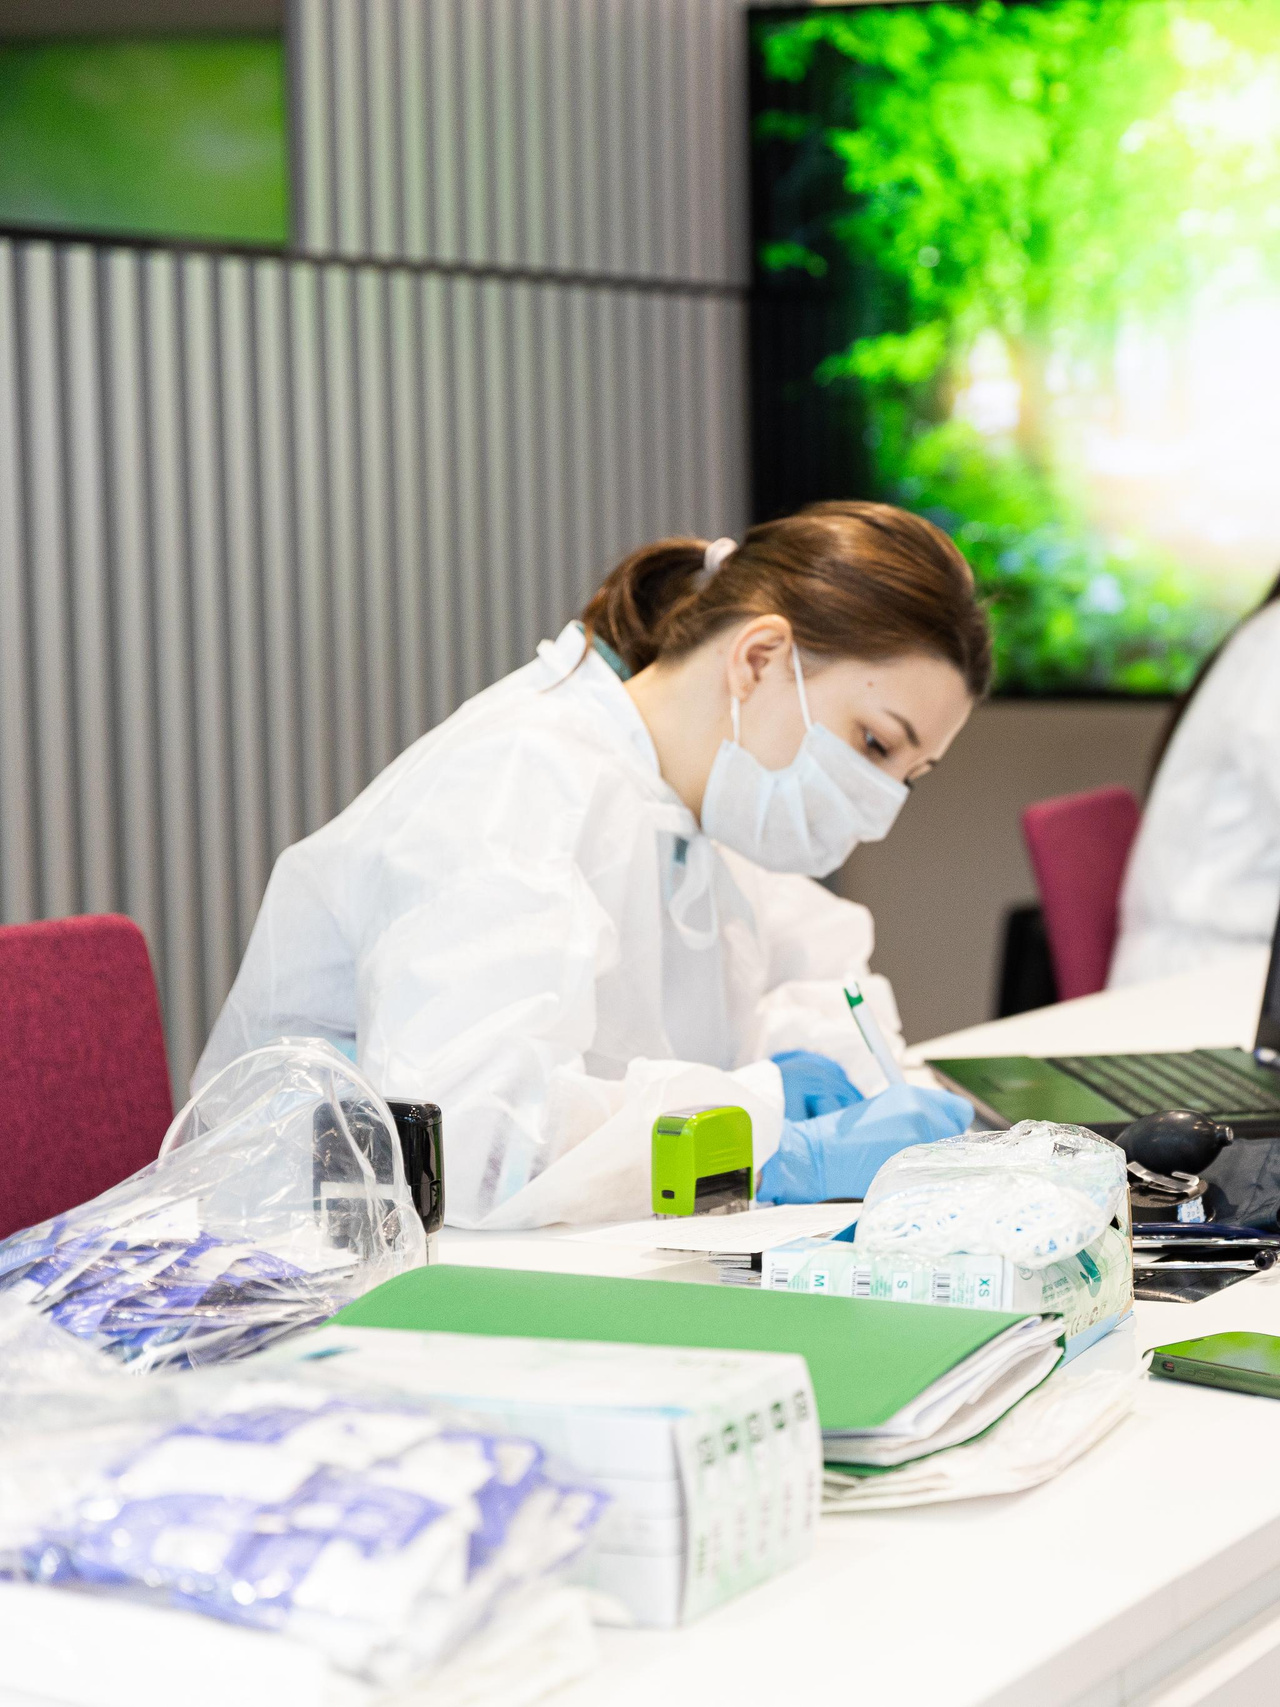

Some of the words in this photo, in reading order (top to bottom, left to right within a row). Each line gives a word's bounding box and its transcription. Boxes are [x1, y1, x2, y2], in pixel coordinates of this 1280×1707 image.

[814, 1274, 825, 1287] M
[897, 1280, 908, 1289] S
[979, 1278, 990, 1298] XS
